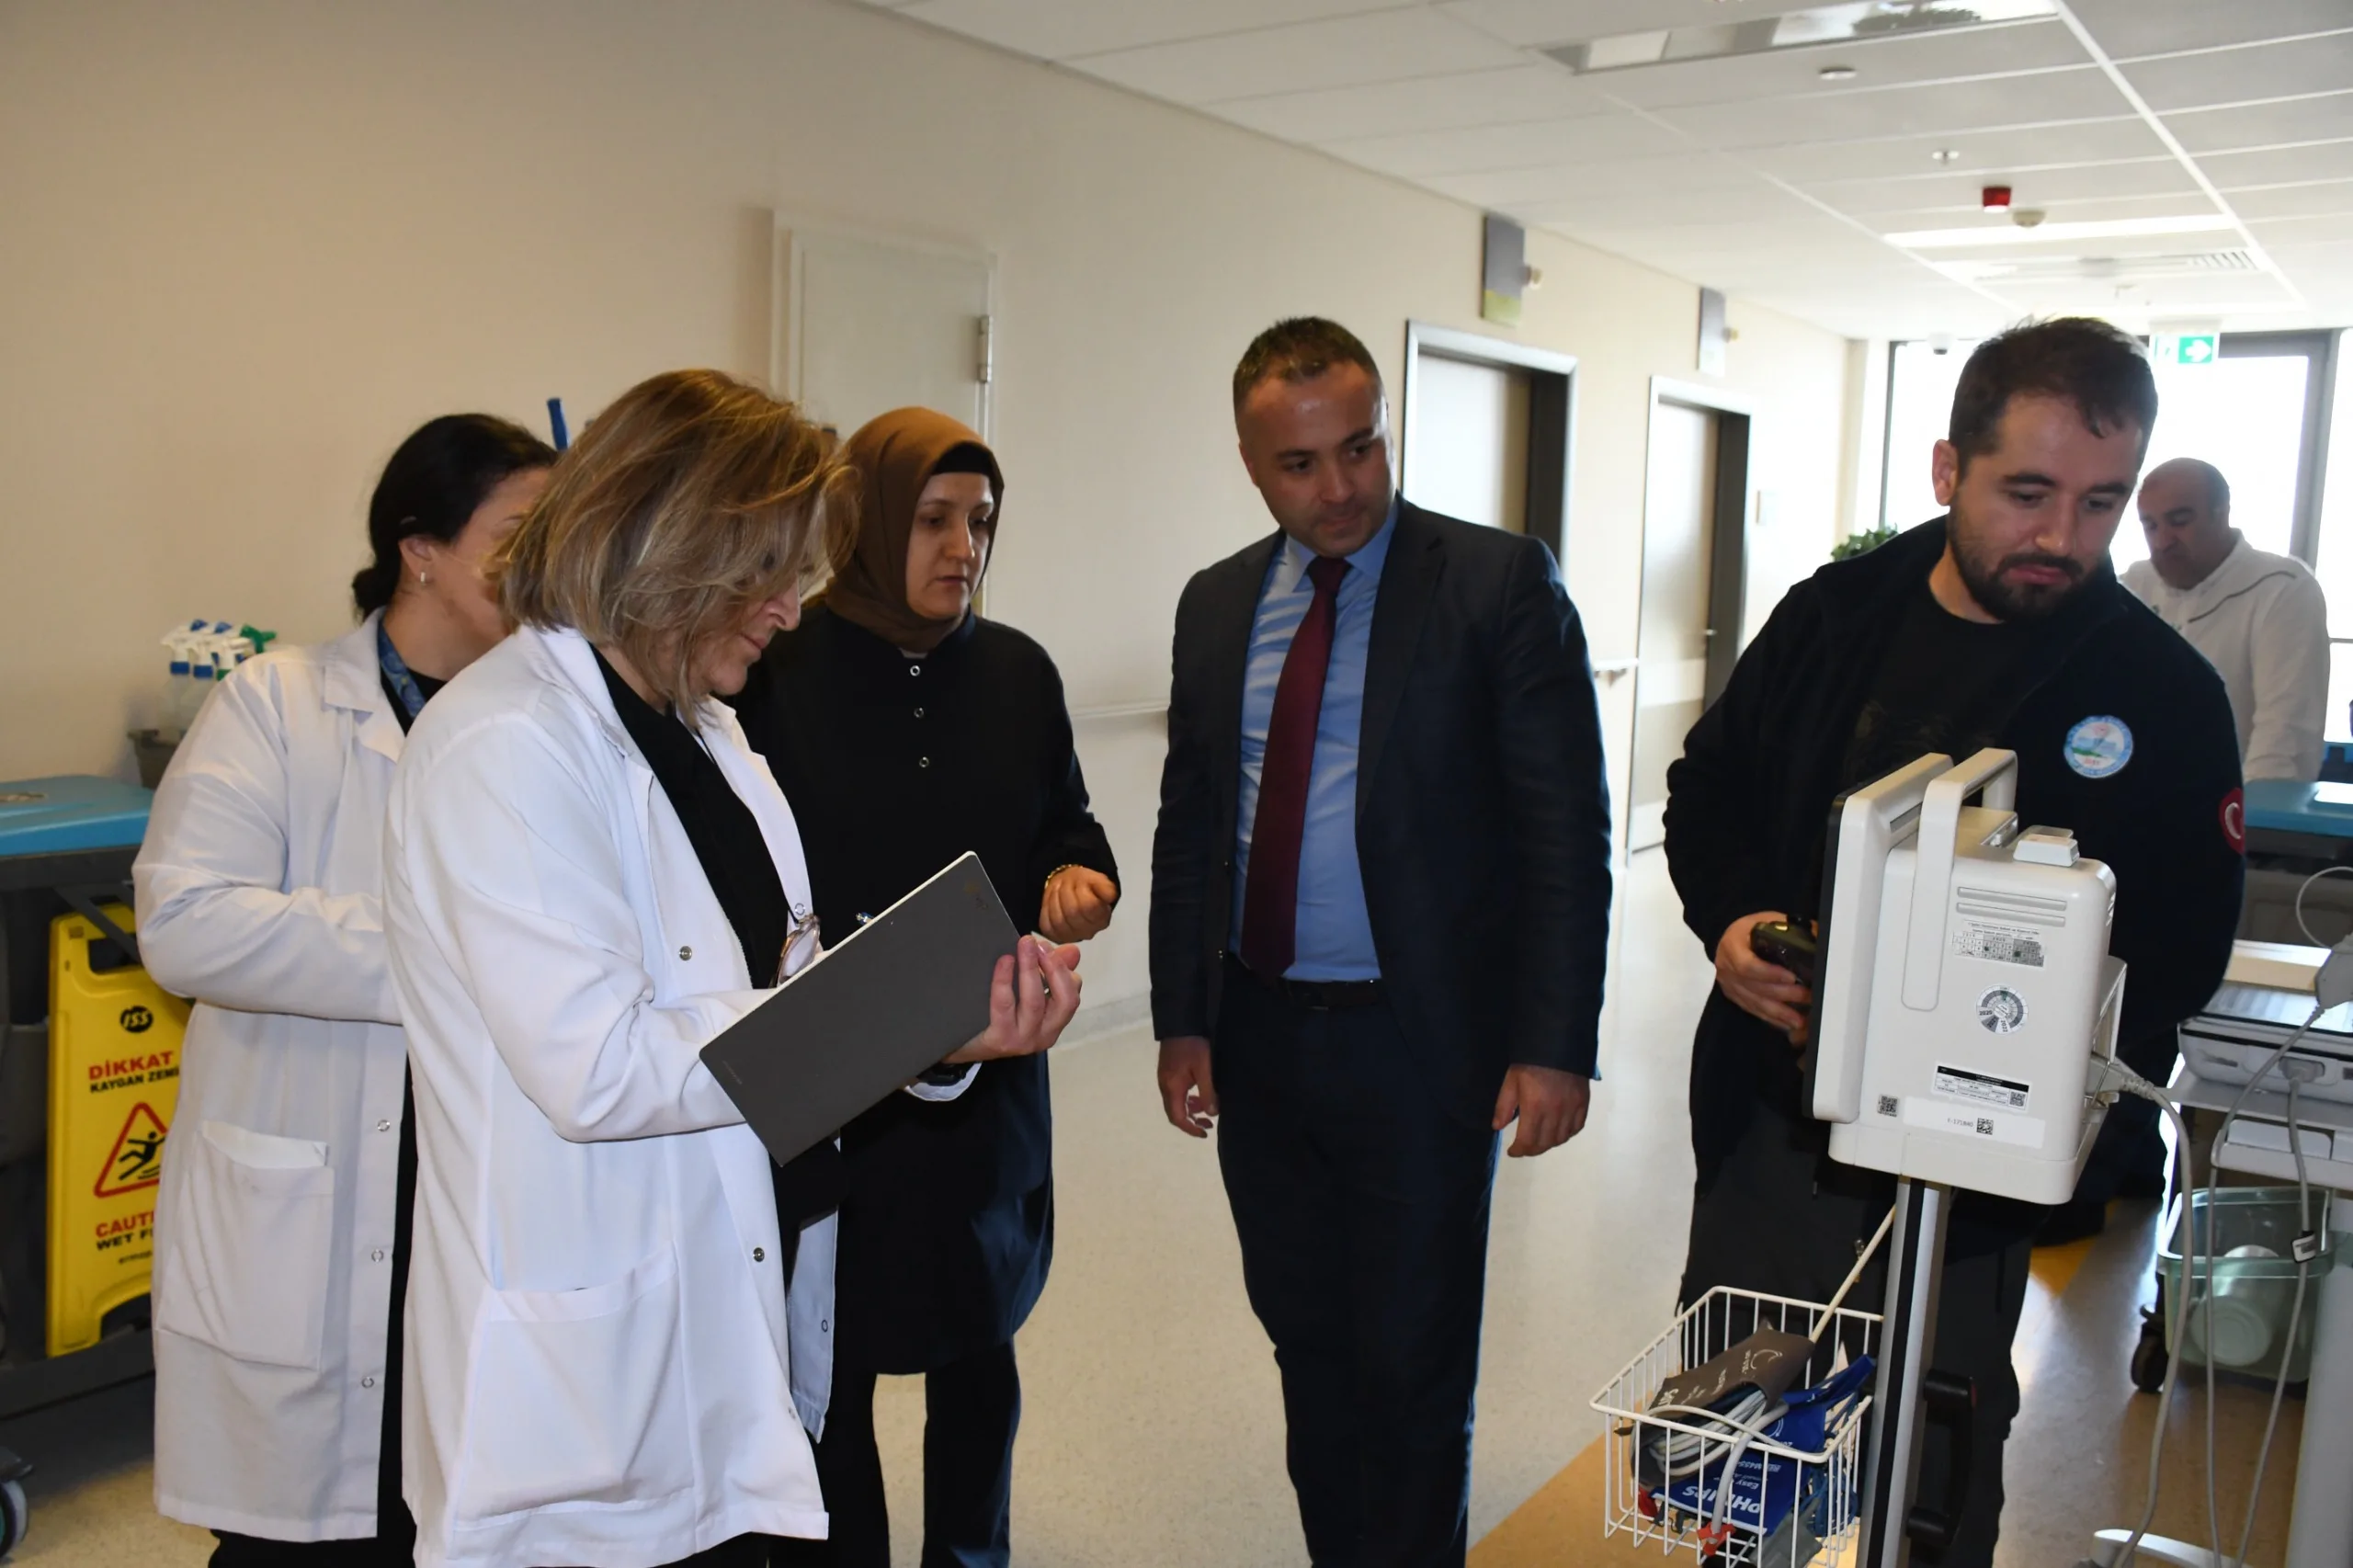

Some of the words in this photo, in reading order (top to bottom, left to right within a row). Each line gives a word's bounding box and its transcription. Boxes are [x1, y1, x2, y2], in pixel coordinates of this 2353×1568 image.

[88, 1051, 174, 1081] DİKKAT
[90, 1074, 144, 1094] KAYGAN
[96, 1210, 154, 1239] CAUTI
[97, 1232, 134, 1251] WET
